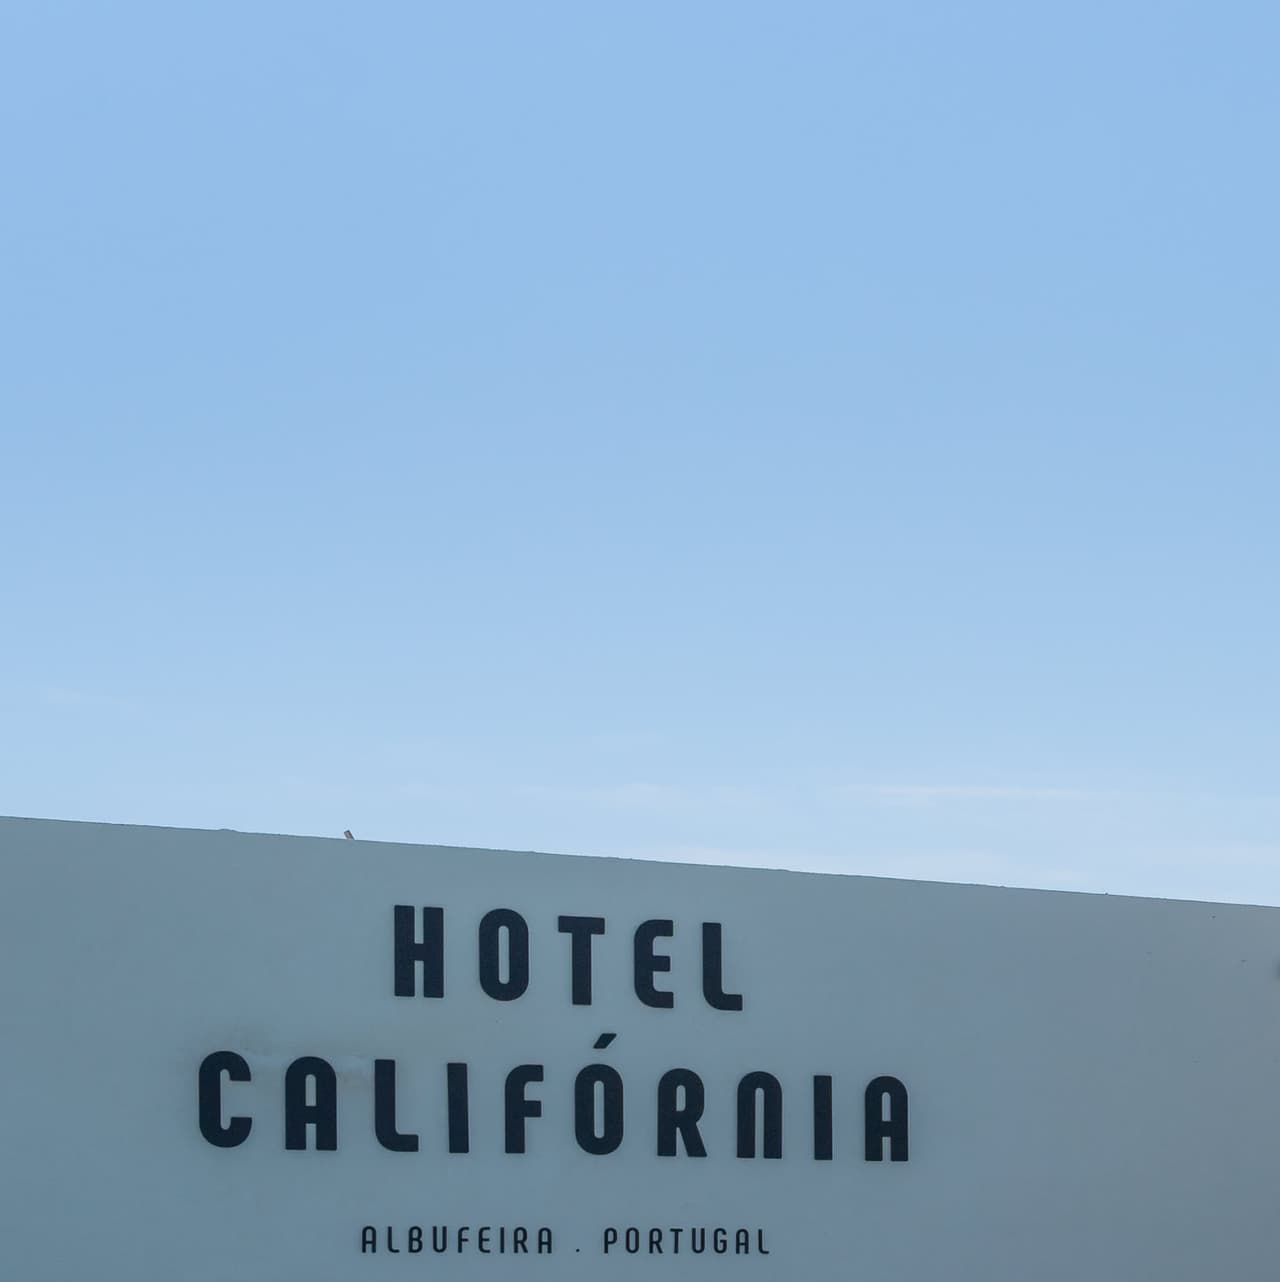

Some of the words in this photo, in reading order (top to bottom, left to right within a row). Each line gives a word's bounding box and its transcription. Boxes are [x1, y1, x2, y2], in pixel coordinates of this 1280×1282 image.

[393, 904, 743, 1012] HOTEL
[197, 1032, 910, 1163] CALIFÓRNIA
[360, 1225, 553, 1255] ALBUFEIRA
[603, 1226, 770, 1255] PORTUGAL
